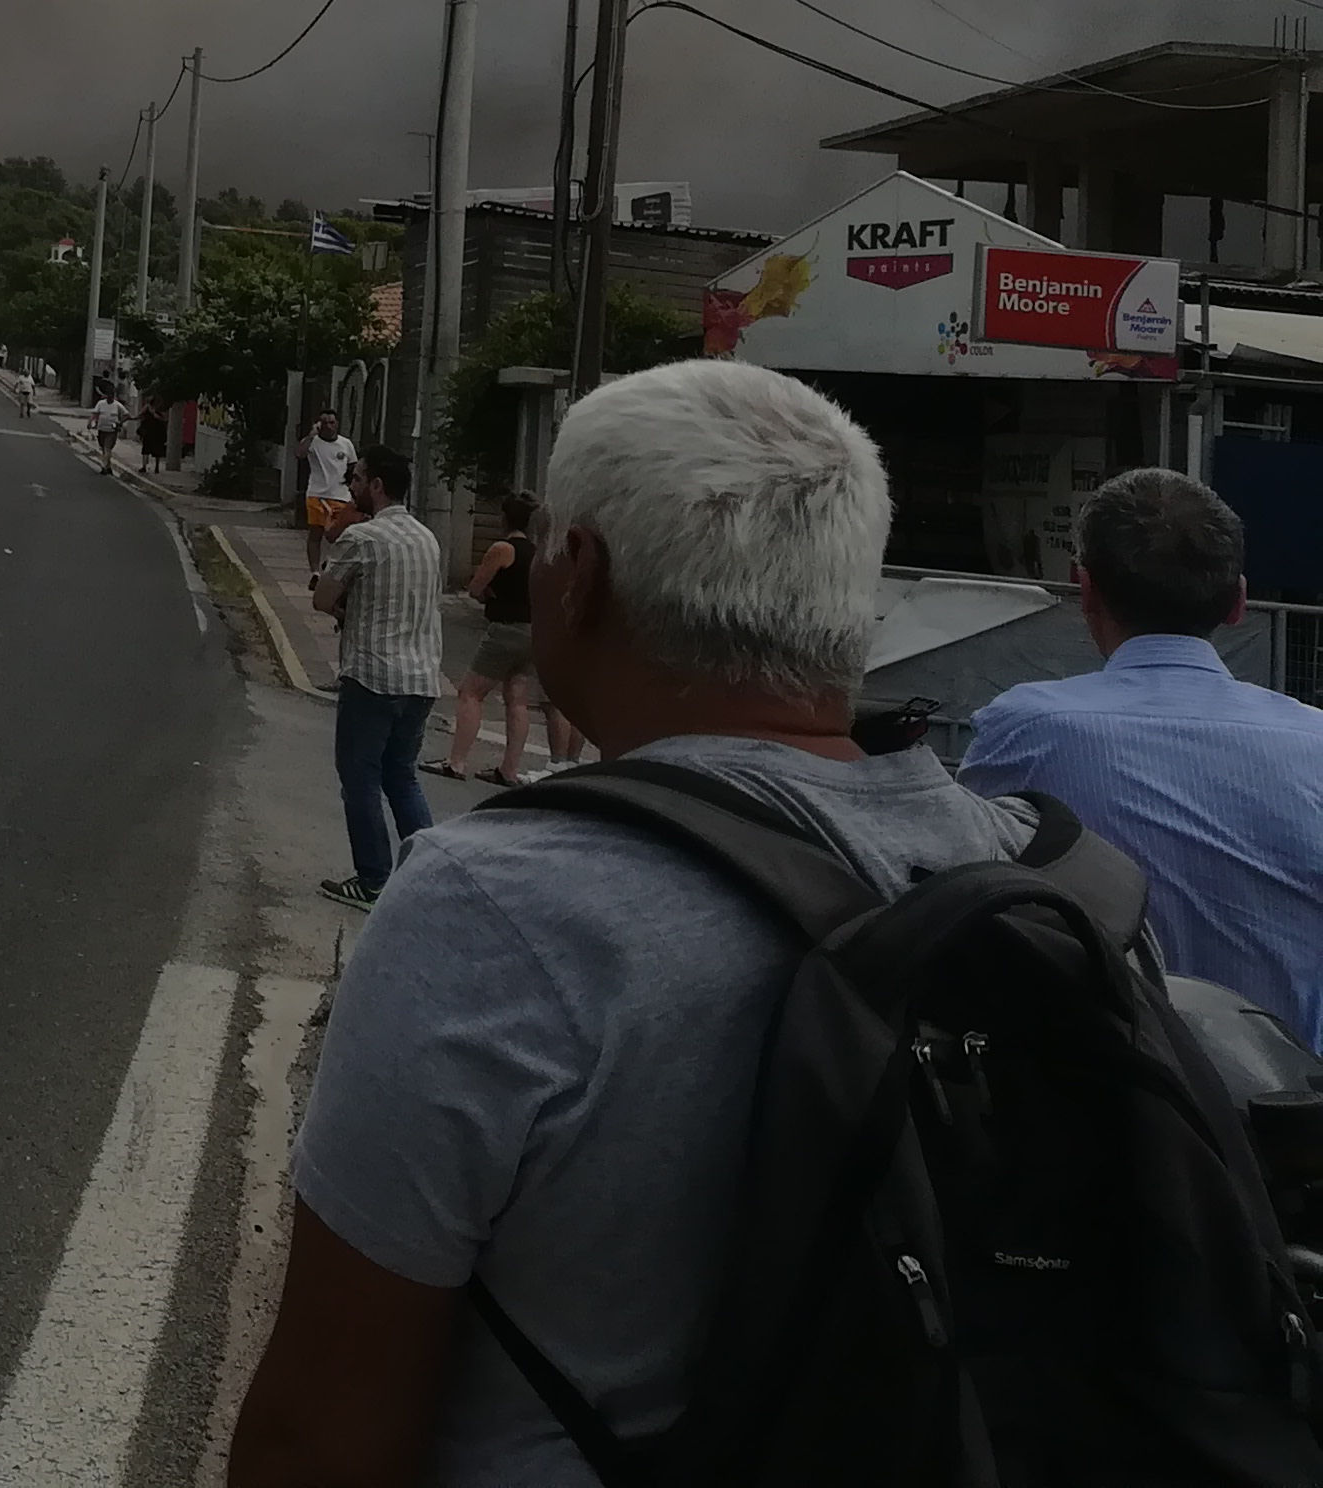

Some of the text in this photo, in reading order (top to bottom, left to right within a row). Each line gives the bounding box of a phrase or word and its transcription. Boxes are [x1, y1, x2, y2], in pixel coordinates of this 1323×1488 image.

[848, 218, 955, 250] KRAFT
[868, 261, 930, 277] paints
[999, 272, 1103, 298] Benjamin
[998, 292, 1071, 316] Moore
[1122, 313, 1173, 326] Benjamin
[1129, 323, 1166, 335] Moore
[994, 1252, 1071, 1270] Samsonite
